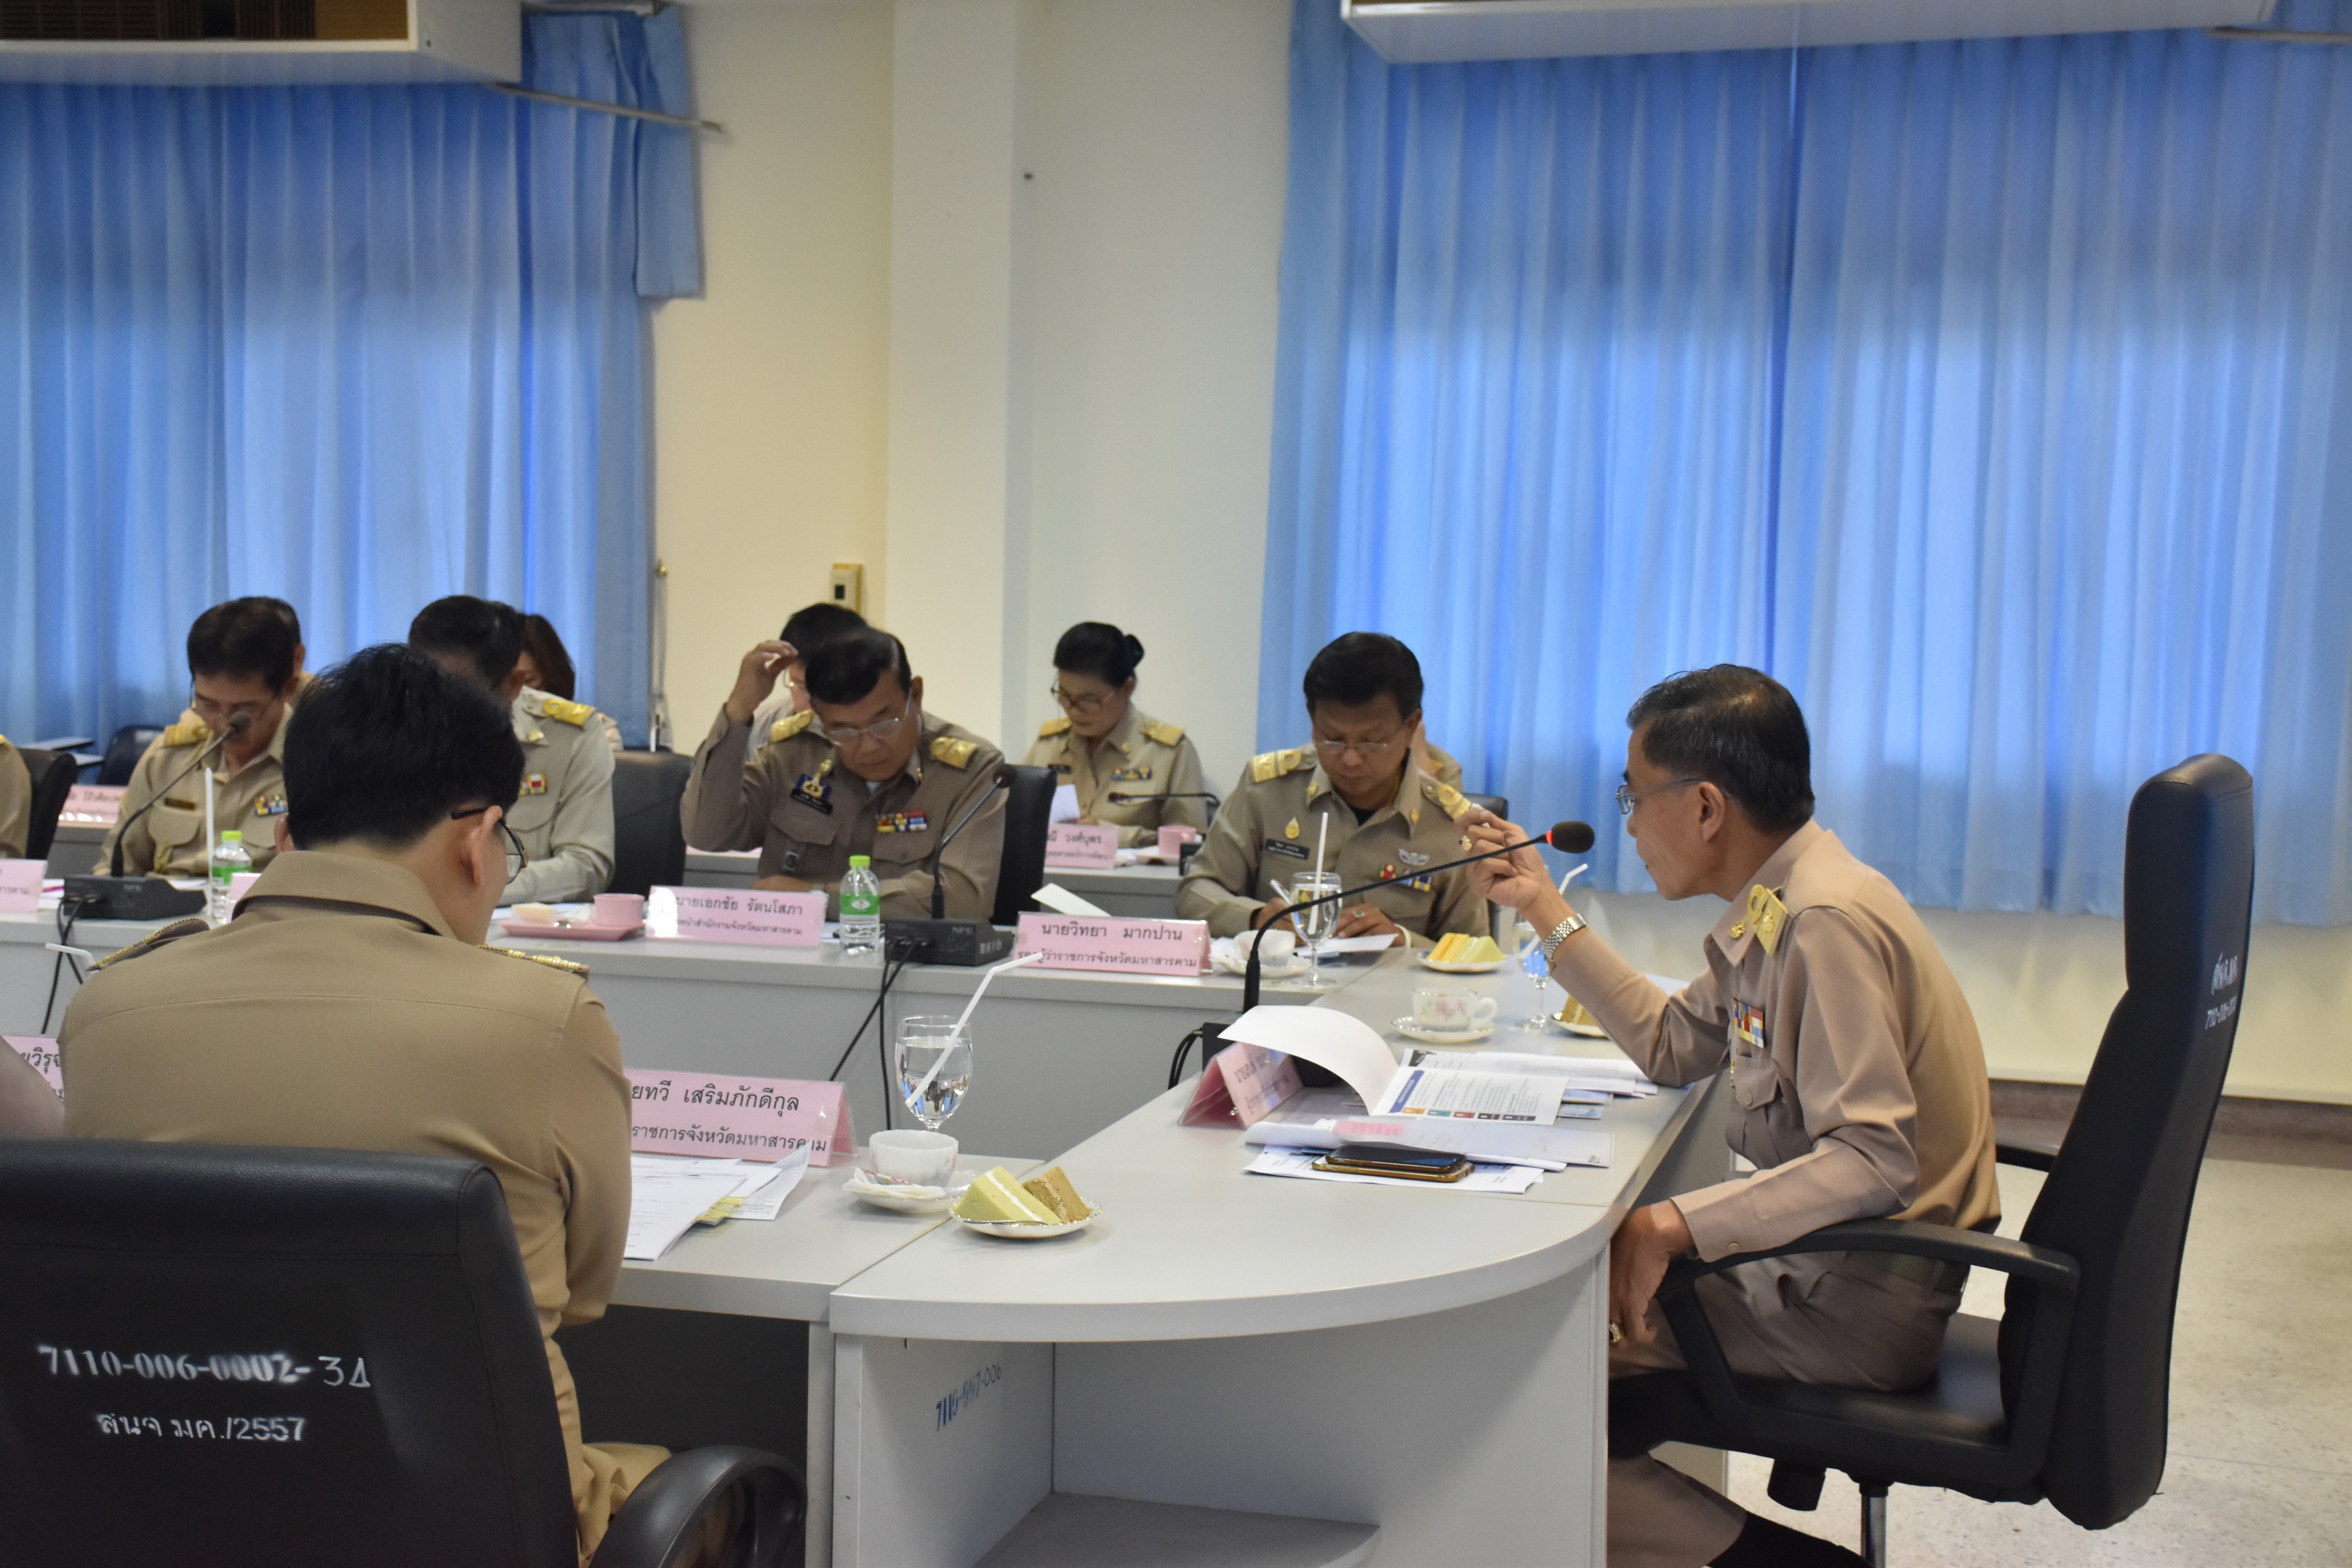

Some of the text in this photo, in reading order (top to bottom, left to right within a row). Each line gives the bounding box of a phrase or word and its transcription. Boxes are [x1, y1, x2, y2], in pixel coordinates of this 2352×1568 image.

[1042, 920, 1183, 941] นายวิทยา มากปาน
[684, 1082, 800, 1118] เสริมภักดีกุล
